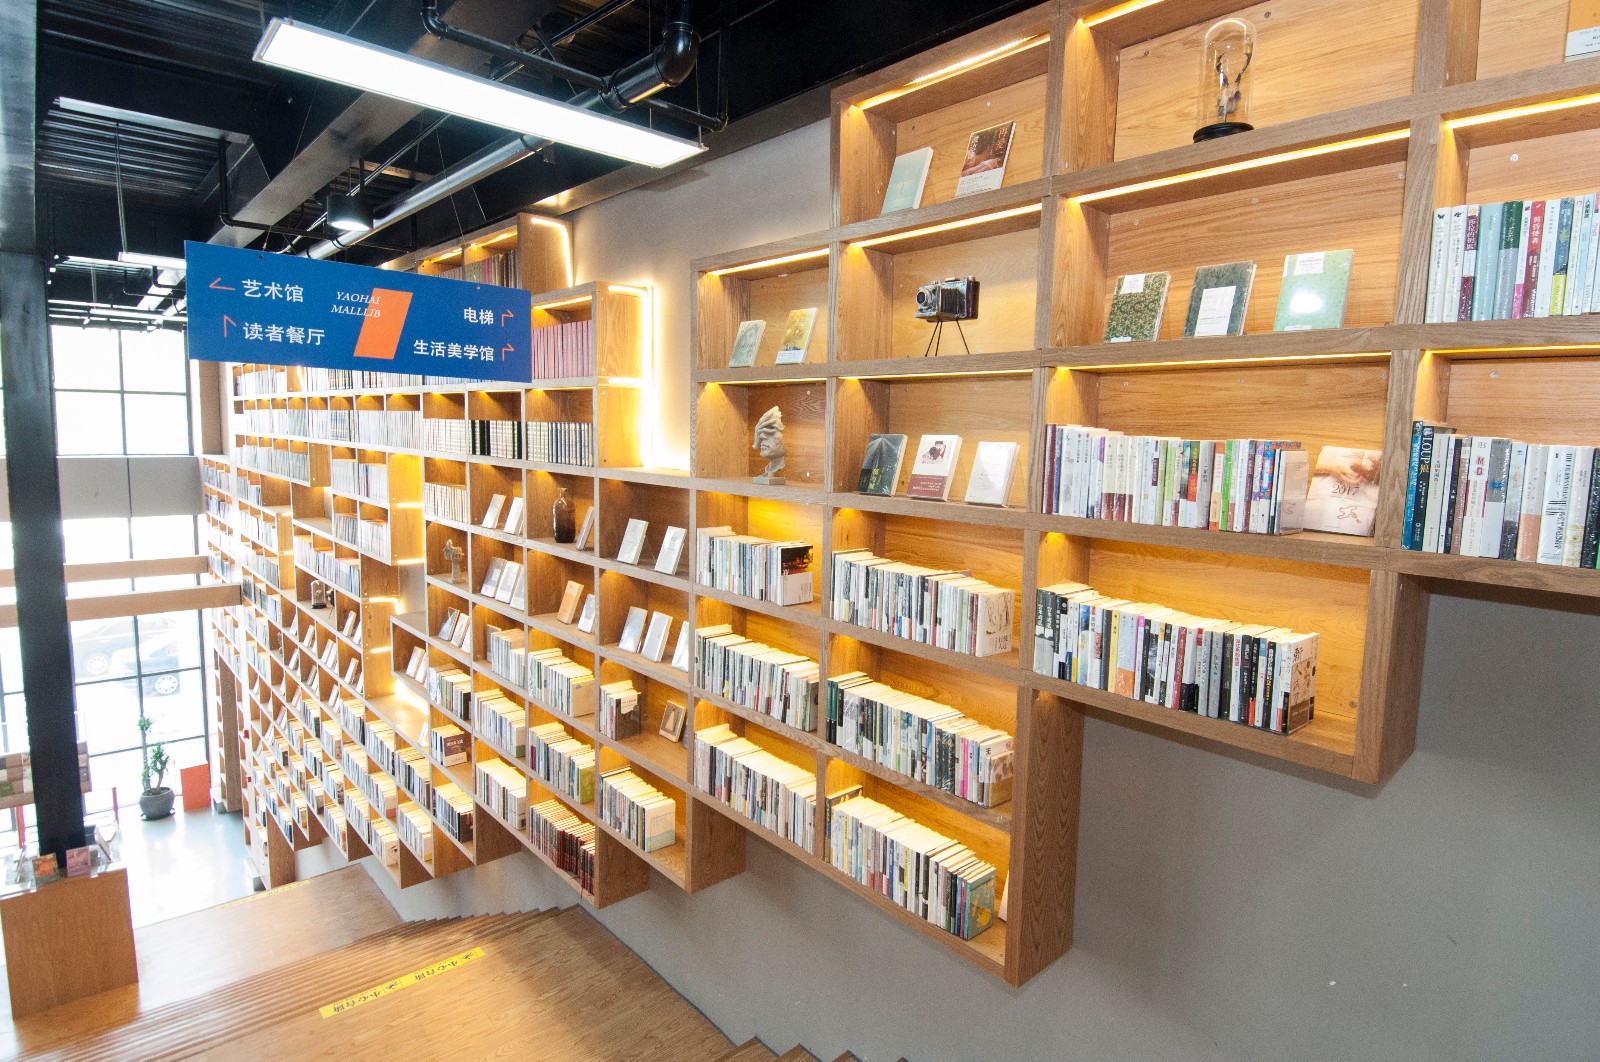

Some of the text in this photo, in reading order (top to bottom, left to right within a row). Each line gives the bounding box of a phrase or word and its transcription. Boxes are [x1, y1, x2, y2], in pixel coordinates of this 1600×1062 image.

[241, 278, 304, 303] 艺术馆
[336, 291, 381, 305] YAOHAI
[331, 306, 381, 318] MALLLIB
[463, 307, 494, 325] 电梯
[242, 322, 325, 346] 读者餐厅
[413, 339, 494, 362] 生活美学馆
[1420, 437, 1433, 464] LOUP
[1332, 484, 1360, 496] 2017
